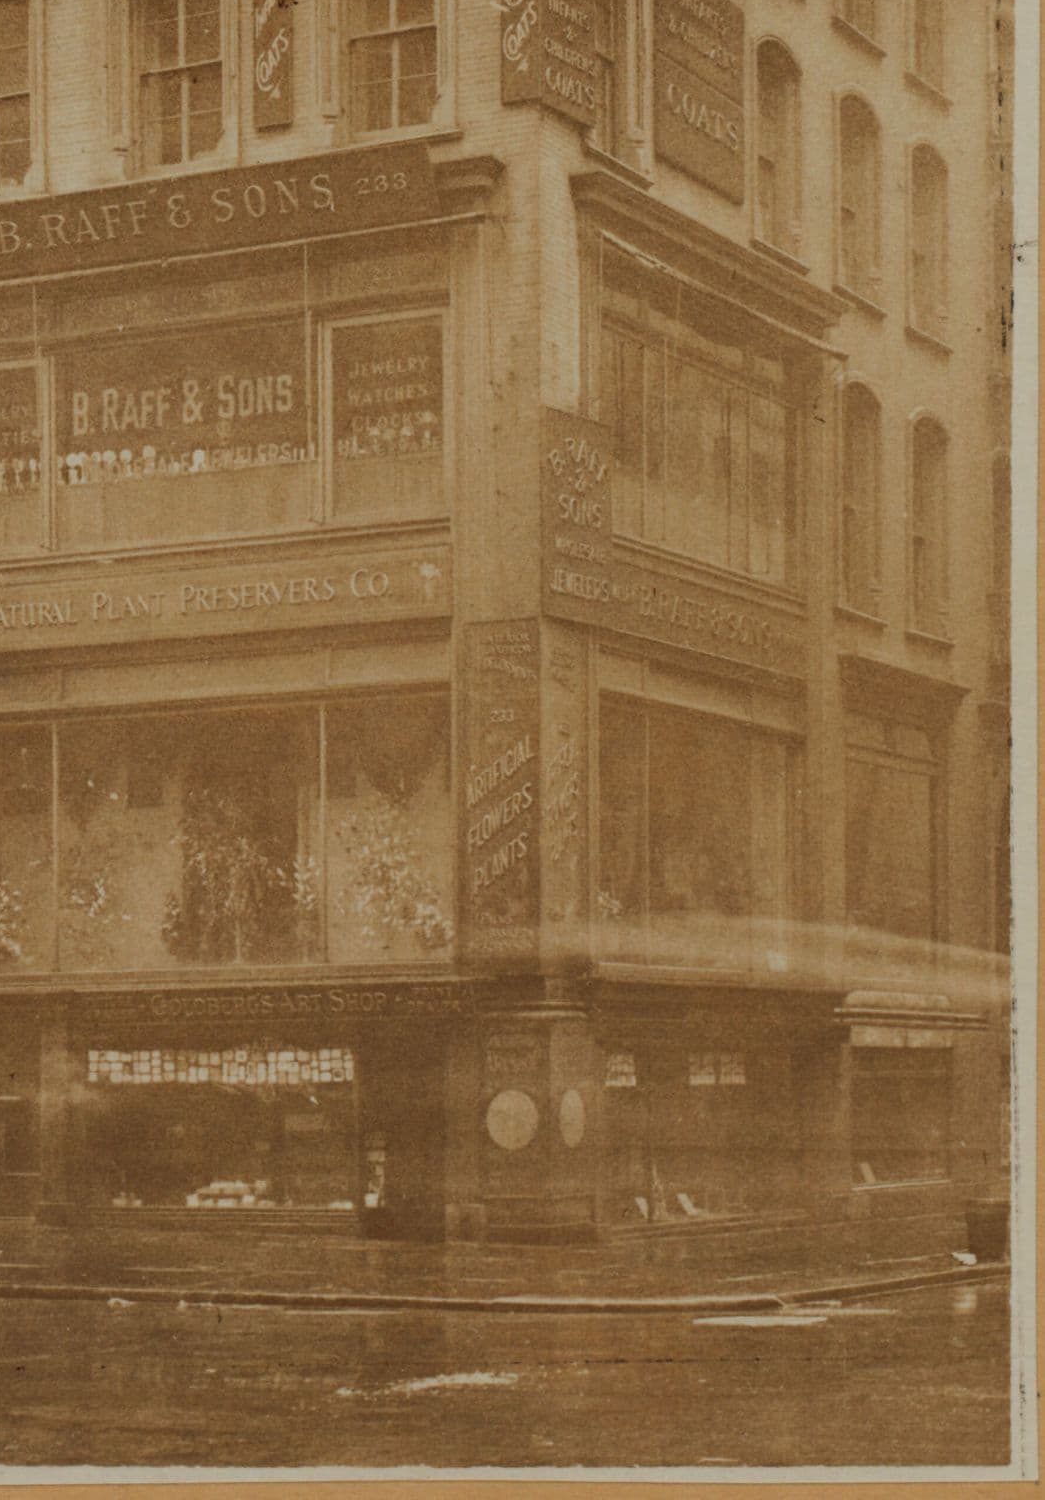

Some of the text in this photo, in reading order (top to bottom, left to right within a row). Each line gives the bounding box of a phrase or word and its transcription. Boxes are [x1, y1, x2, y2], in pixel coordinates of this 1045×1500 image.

[545, 66, 595, 111] COATS
[667, 82, 739, 151] COATS
[355, 171, 409, 196] 233
[42, 200, 148, 248] RAFF
[167, 193, 193, 230] &
[213, 171, 335, 224] SONS
[348, 354, 431, 380] JEWELRY
[102, 386, 172, 432] RAFF
[182, 379, 204, 425] &
[217, 374, 294, 419] SONS
[347, 383, 429, 407] WATCHES
[557, 493, 603, 529] SONS
[90, 590, 166, 622] PLANT
[179, 577, 336, 619] PRESERVERS
[466, 734, 536, 808] ARTIFICIAL
[468, 782, 534, 854] FLOWERS
[473, 831, 529, 896] PLANTS
[280, 992, 323, 1013] ART
[329, 988, 388, 1012] SHOP
